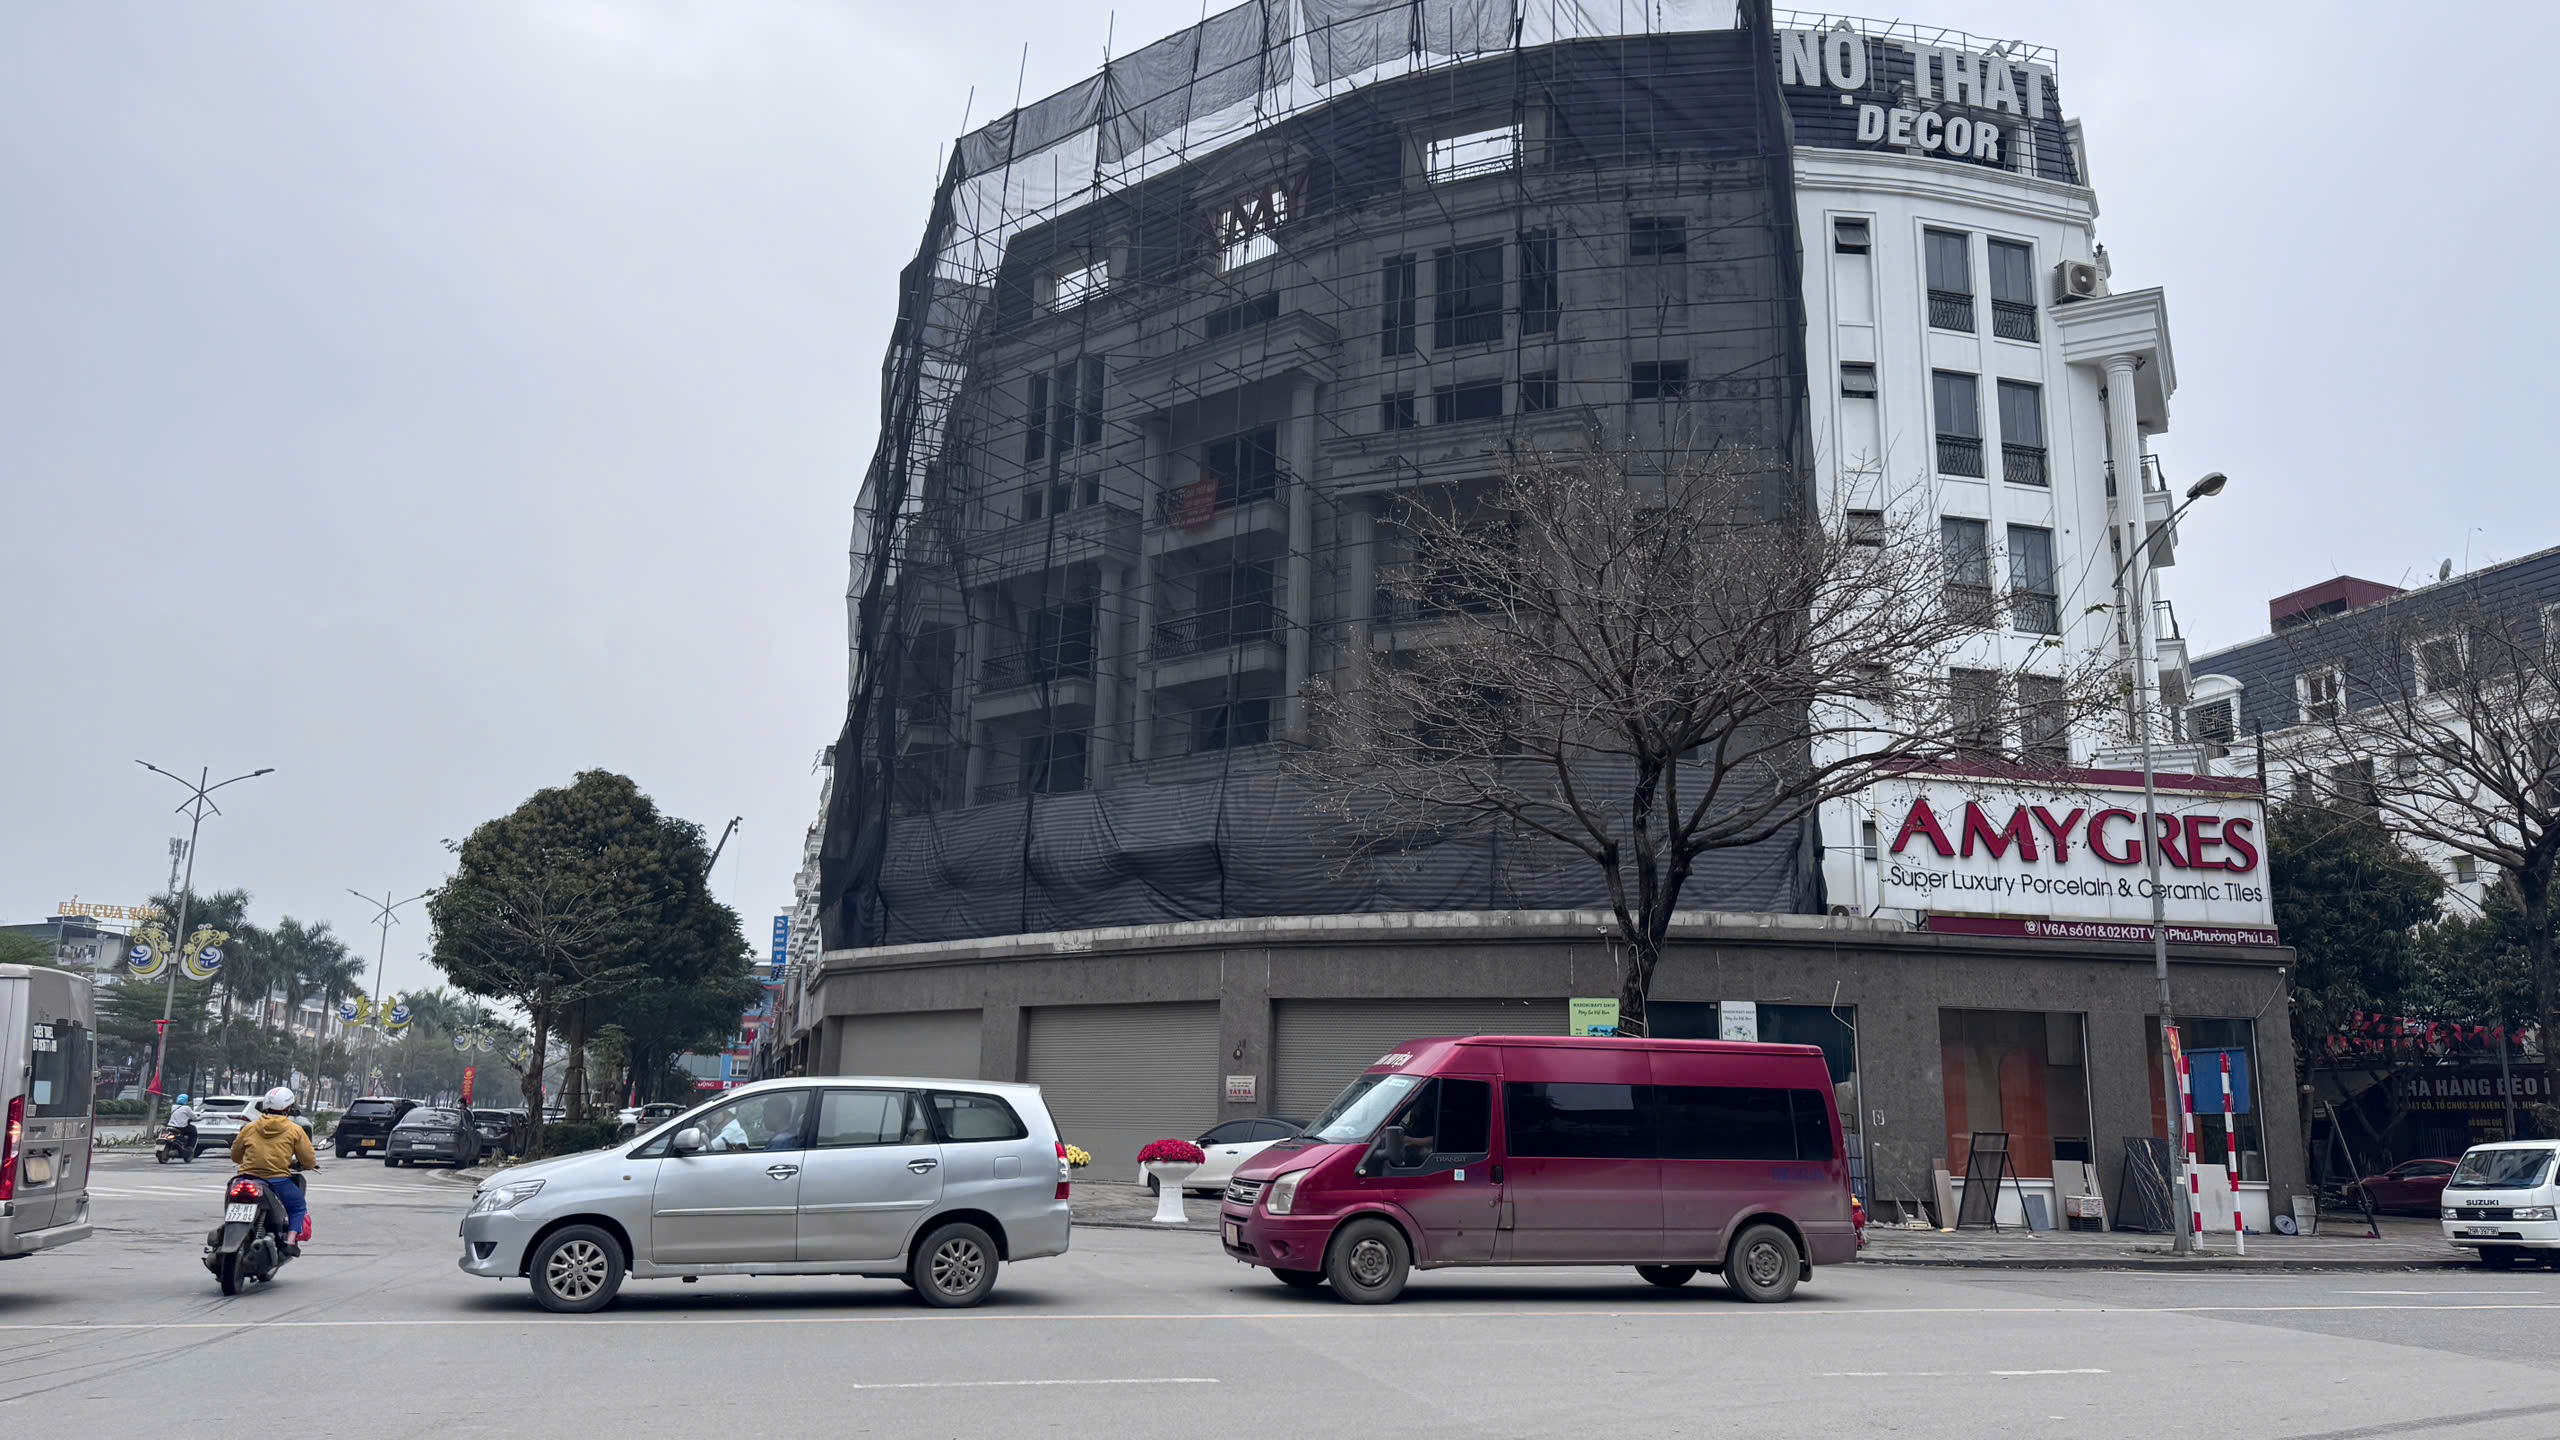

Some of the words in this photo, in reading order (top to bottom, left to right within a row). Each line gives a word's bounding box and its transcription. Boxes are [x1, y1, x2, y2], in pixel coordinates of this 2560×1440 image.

[1902, 40, 2052, 119] THẤT
[1856, 104, 2000, 161] DECOR
[1890, 799, 2260, 874] AMYGRES
[1890, 866, 1948, 890] Super
[1952, 870, 2015, 896] Luxury
[2021, 872, 2113, 898] Porcelain
[2118, 877, 2133, 898] &
[2138, 878, 2220, 902] Ceramic
[2224, 880, 2263, 902] Tiles
[2043, 923, 2068, 936] V6A
[2121, 927, 2146, 939] KĐT
[2238, 931, 2257, 943] Phú
[2399, 1075, 2432, 1097] HÀ
[2435, 1075, 2491, 1097] HÀNG
